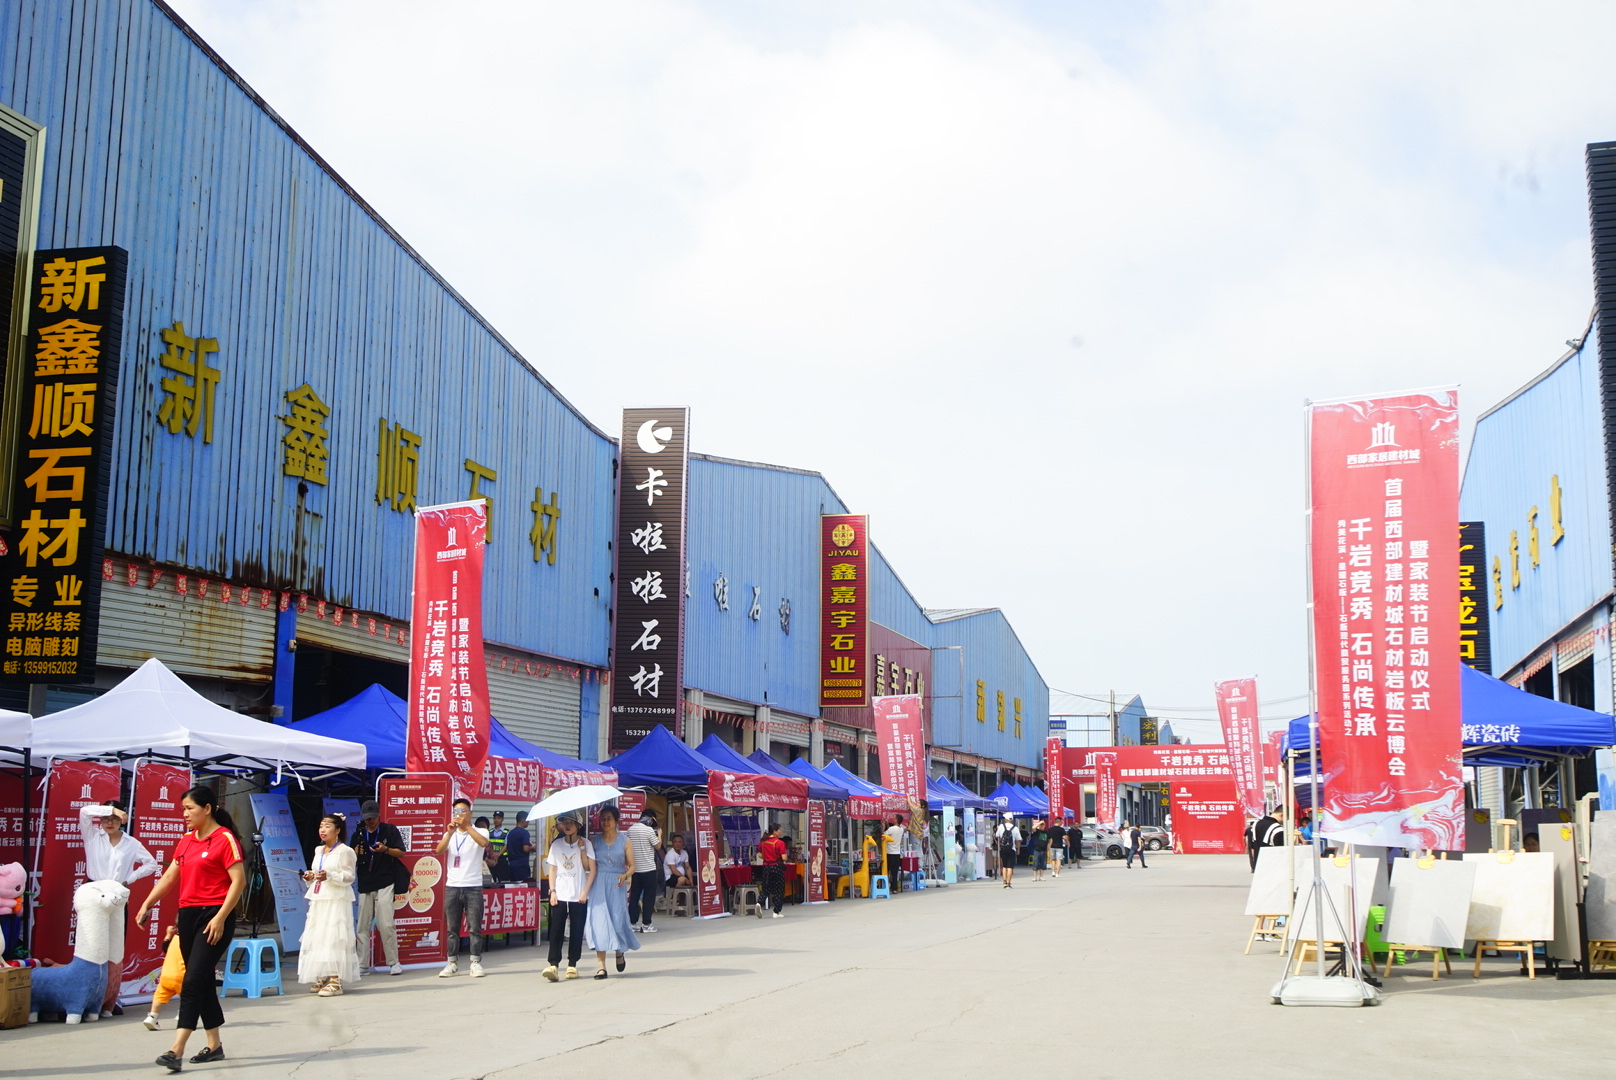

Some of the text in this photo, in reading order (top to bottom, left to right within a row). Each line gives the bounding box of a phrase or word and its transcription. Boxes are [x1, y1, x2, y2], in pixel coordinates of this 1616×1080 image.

[18, 256, 106, 568] 新鑫顺石材
[156, 321, 561, 565] 新鑫顺石材
[1347, 449, 1420, 465] 西部家居建材城
[8, 612, 82, 632] 异形线条
[10, 574, 83, 608] 专业
[629, 467, 668, 699] 卡啦啦石材
[830, 563, 856, 673] 鑫嘉宇石业
[1350, 518, 1377, 736] 千岩竞秀 石尚传承
[1385, 478, 1405, 776] 首届西部建材城石材岩板云博会
[1409, 540, 1431, 710] 暨家装节启动仪式
[1459, 565, 1479, 669] 宝龙石
[5, 636, 80, 658] 电脑雕刻
[23, 661, 77, 676] 13599152032
[426, 600, 448, 762] 千岩竞秀 石尚传承
[458, 618, 479, 744] 暨家装节启动仪式
[1142, 719, 1157, 745] 宏利
[1160, 756, 1203, 766] 千岩竞秀
[1461, 724, 1521, 743] 辉瓷砖
[1160, 782, 1170, 806] 石业
[148, 850, 164, 949] 商家直播区
[463, 891, 536, 932] 居全屋定制
